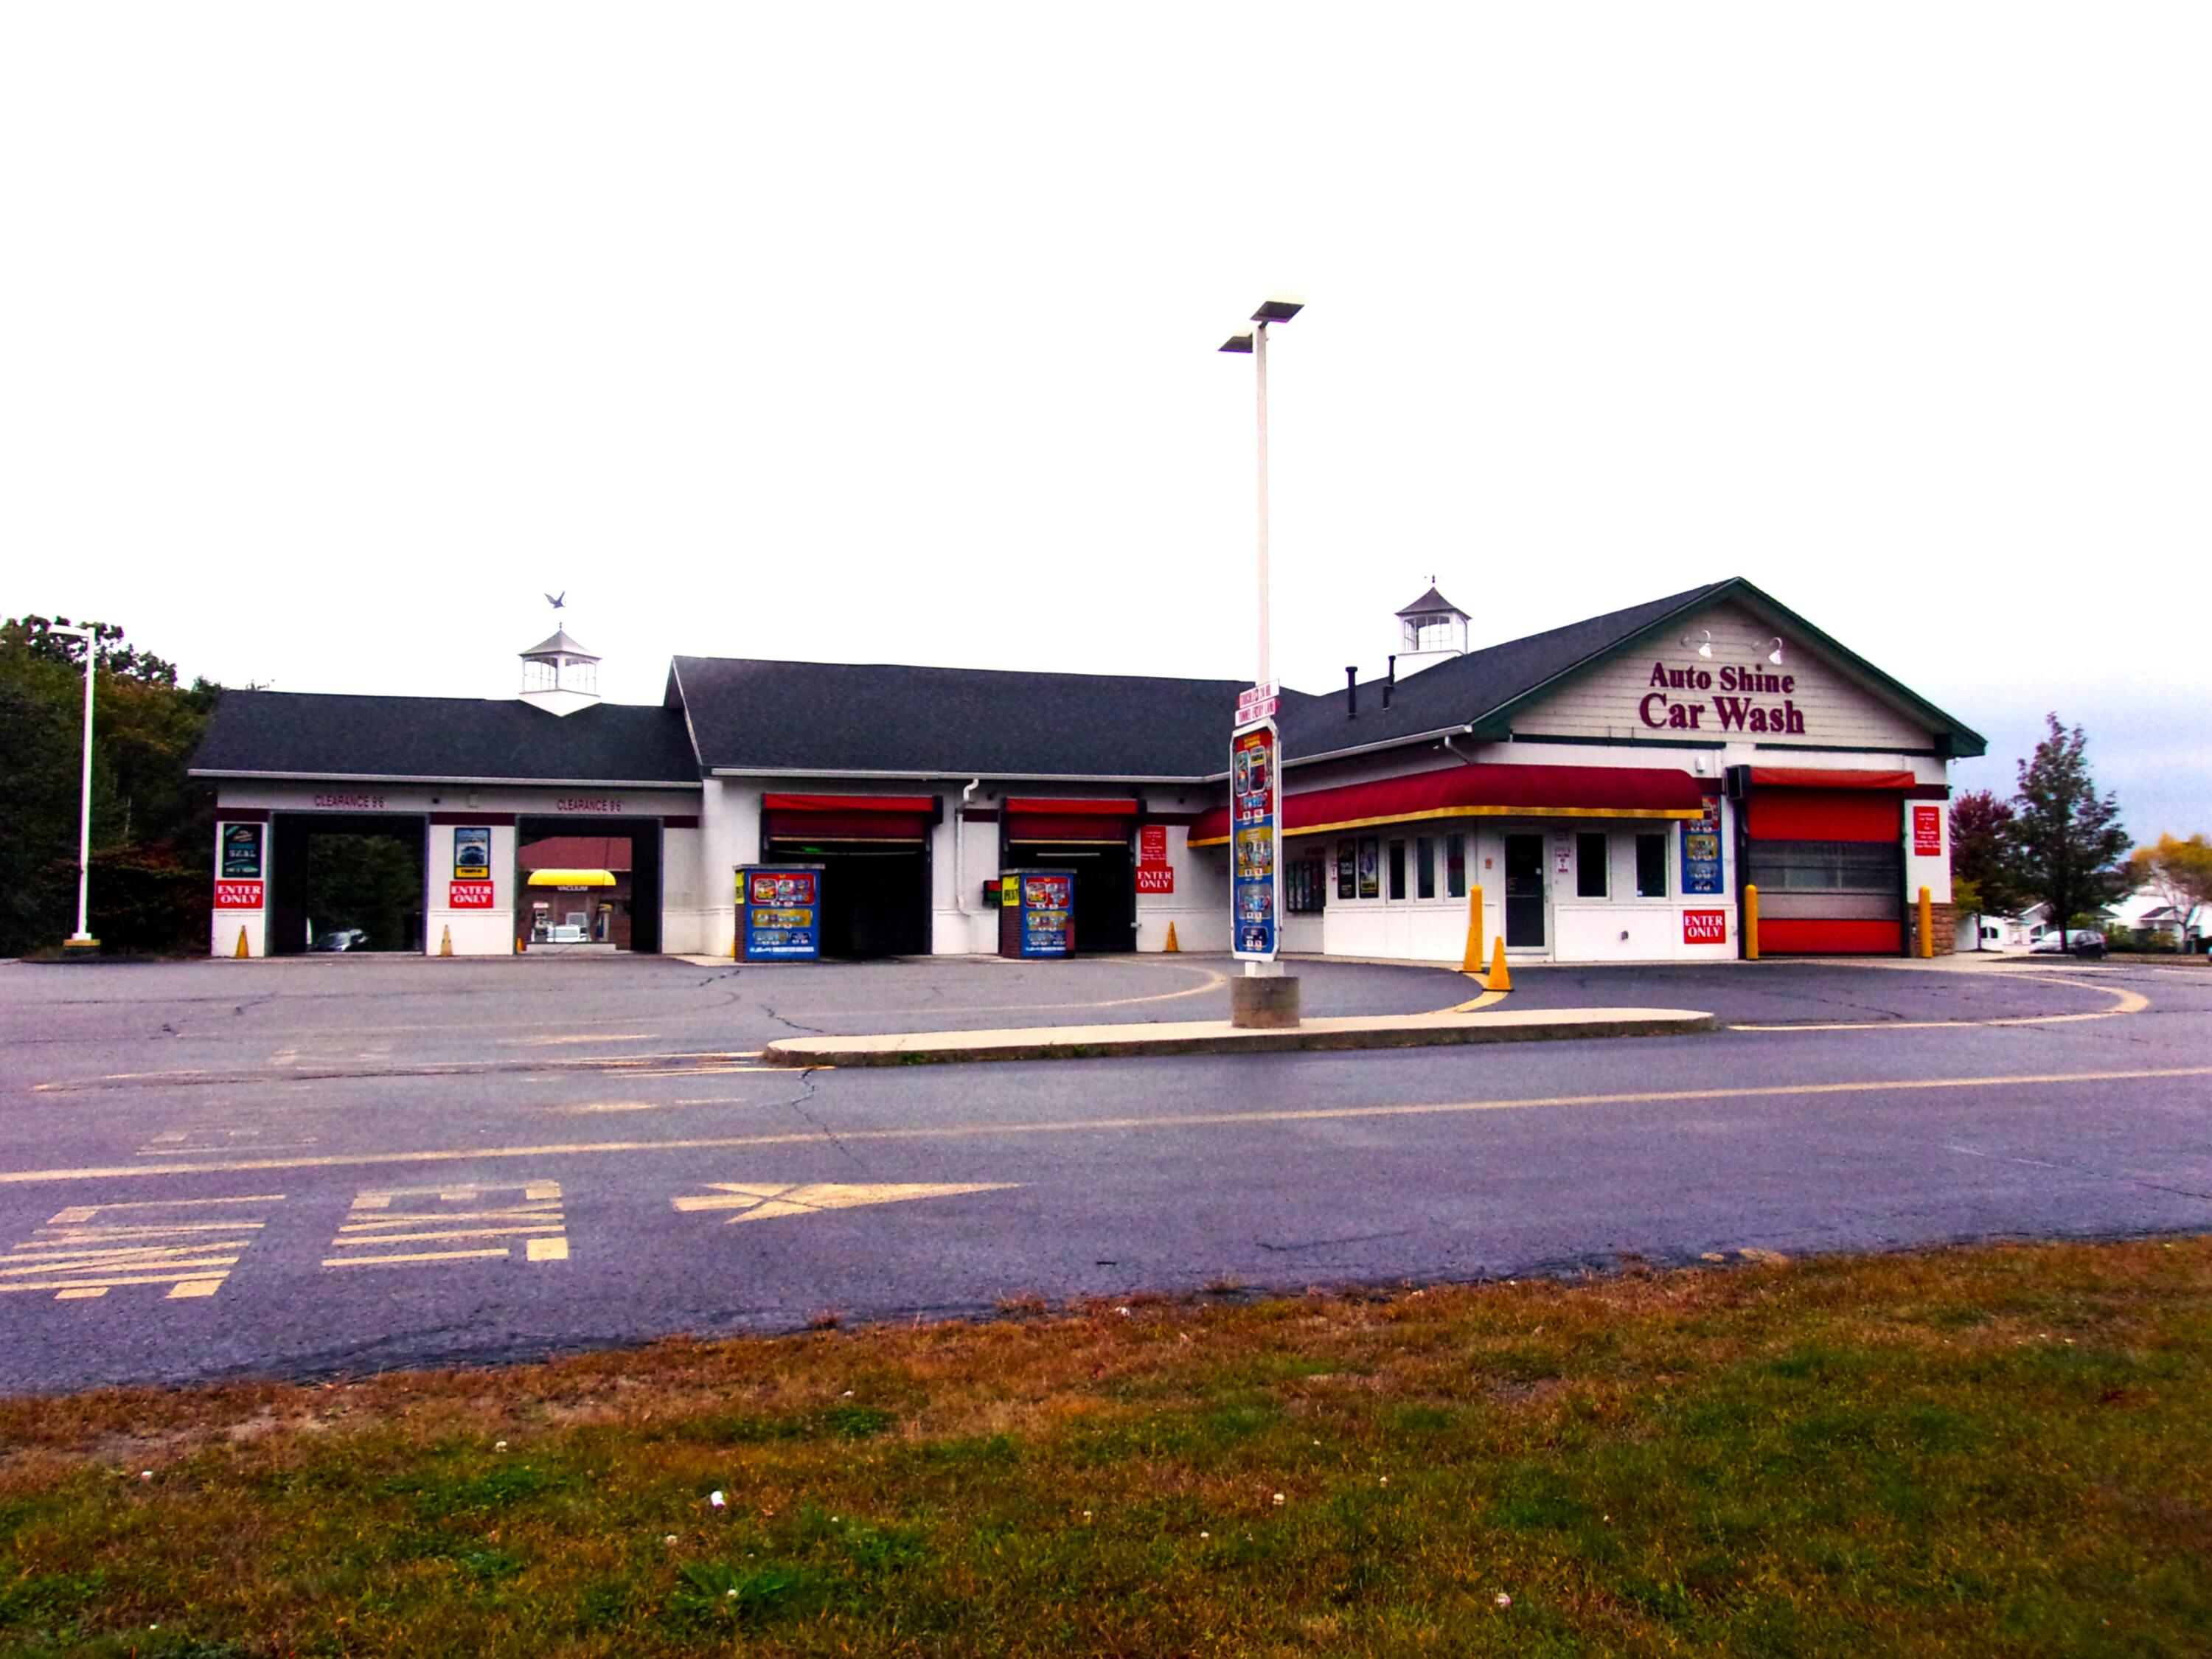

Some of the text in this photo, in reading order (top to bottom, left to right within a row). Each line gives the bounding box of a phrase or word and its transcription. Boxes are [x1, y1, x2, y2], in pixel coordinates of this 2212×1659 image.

[1649, 662, 1795, 694] Auto Shine
[1639, 692, 1805, 734] Car Wash
[315, 795, 369, 807] CLEARANCE
[557, 799, 608, 811] CLEARANCE
[1137, 871, 1172, 880] ENTER
[1140, 880, 1169, 888] ONLY
[218, 885, 261, 894] ENTER
[451, 886, 492, 894] ENTER
[220, 894, 258, 904] ONLY
[453, 894, 488, 903] ONLY
[1685, 915, 1723, 926] ENTER
[1688, 926, 1720, 937] ONLY
